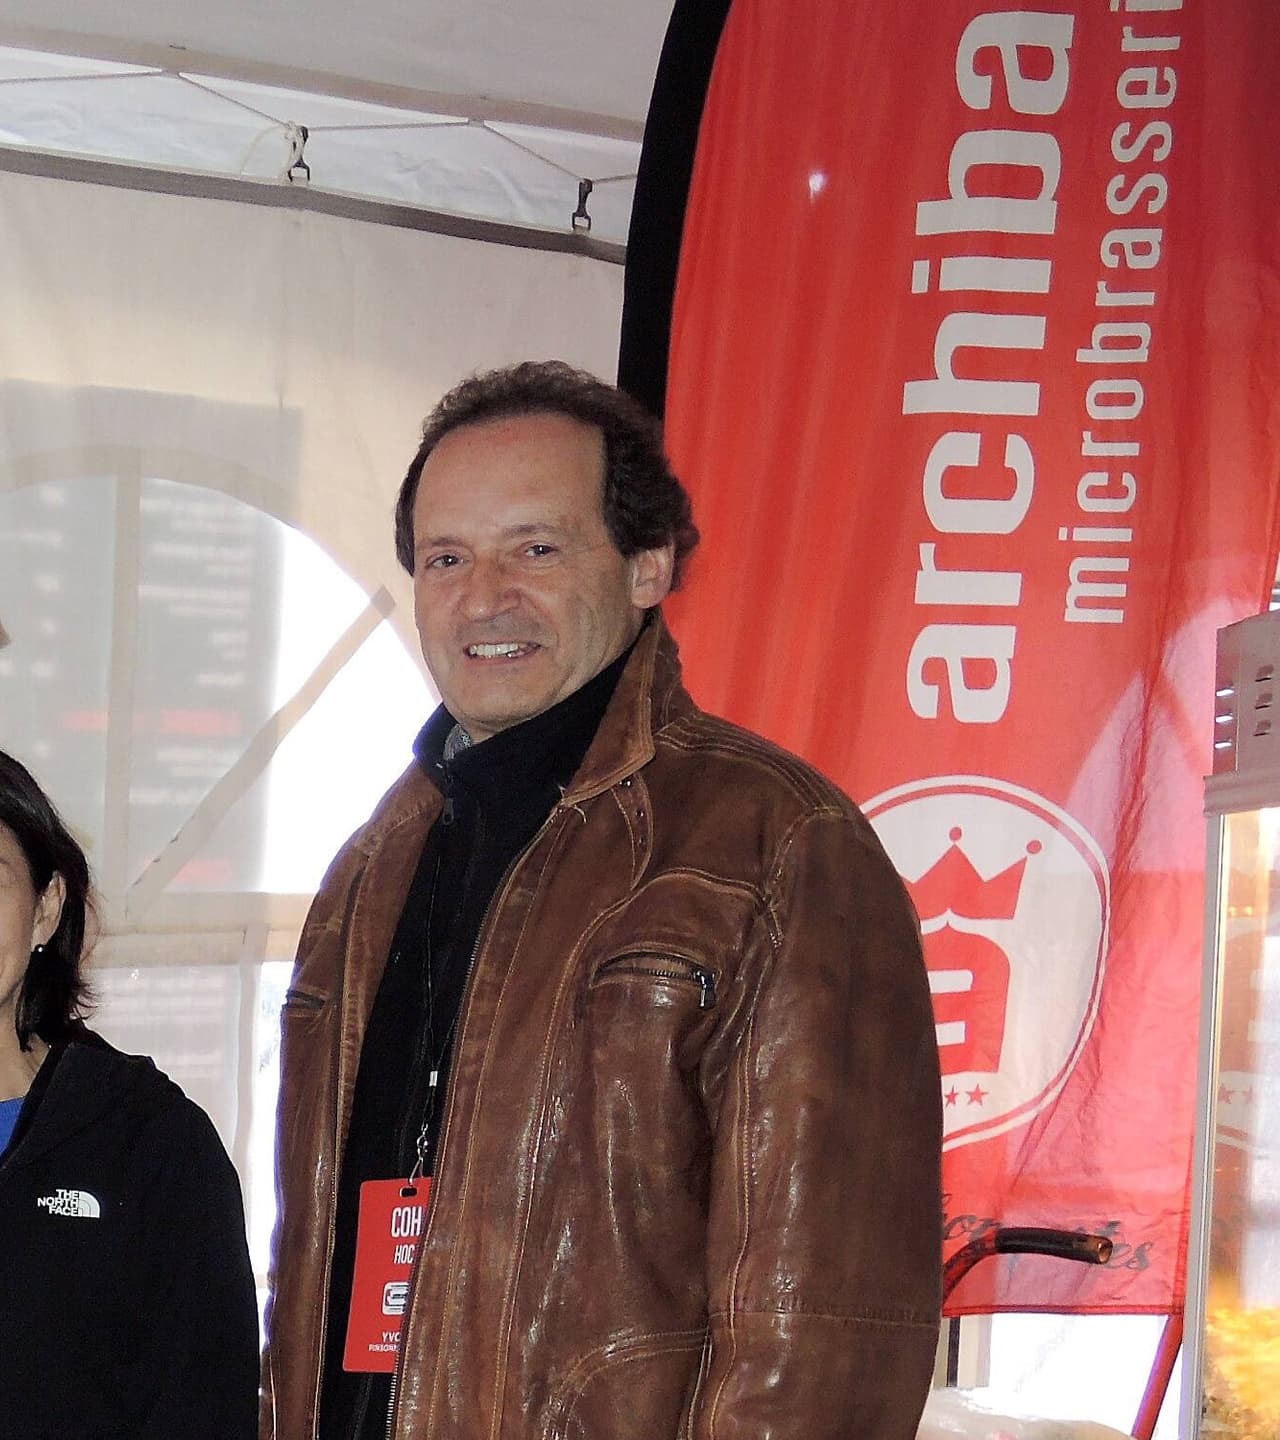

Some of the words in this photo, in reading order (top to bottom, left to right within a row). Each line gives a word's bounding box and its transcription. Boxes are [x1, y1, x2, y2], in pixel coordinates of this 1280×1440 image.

[903, 10, 1075, 724] archiba
[55, 1189, 79, 1200] THE
[37, 1197, 79, 1208] NORTH
[48, 1205, 79, 1217] FACE
[391, 1206, 423, 1238] COH
